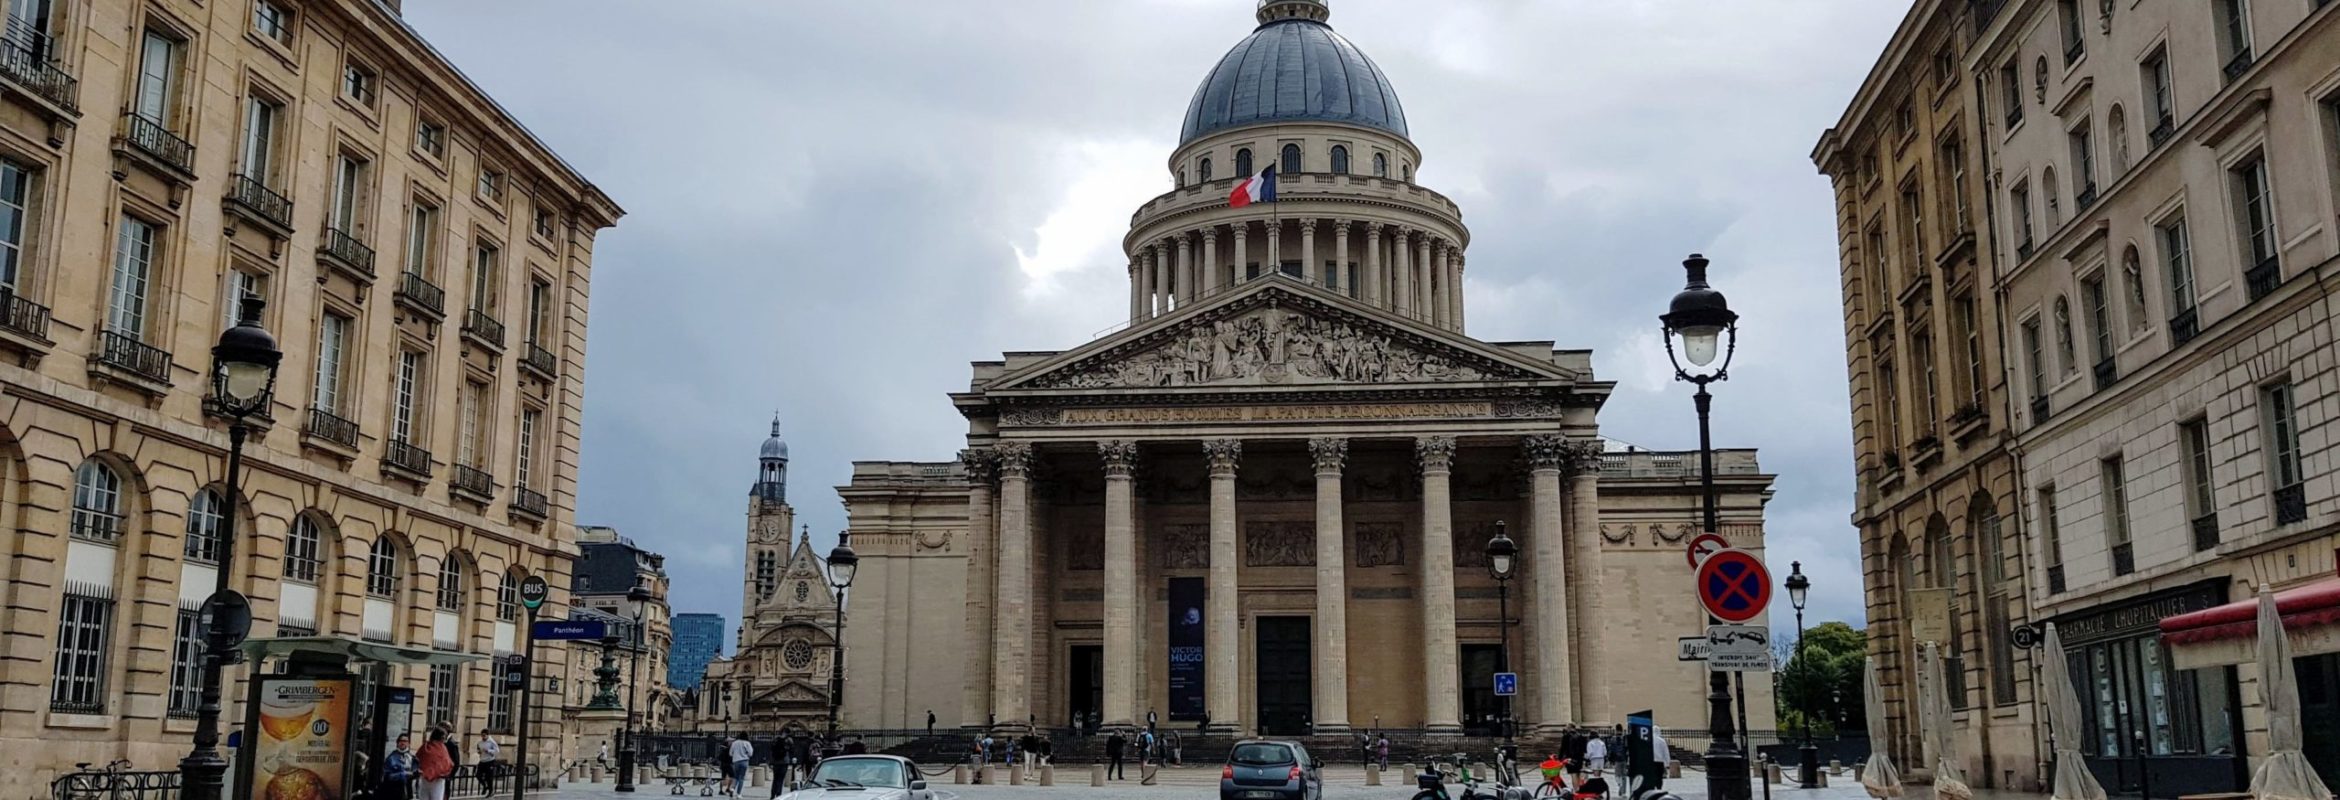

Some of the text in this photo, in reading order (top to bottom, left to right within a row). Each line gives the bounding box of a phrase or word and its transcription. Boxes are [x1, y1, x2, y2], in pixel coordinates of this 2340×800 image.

[1066, 403, 1486, 423] AUX GRANDS HOMMES LA PATRIE RECONNAISSANTE
[524, 584, 543, 594] BUS
[553, 626, 584, 634] Panthéon
[2059, 614, 2106, 639] PHARMACIE
[2018, 631, 2031, 643] 21
[1171, 654, 1203, 662] HUGO
[278, 685, 335, 694] GRIMBERGEN
